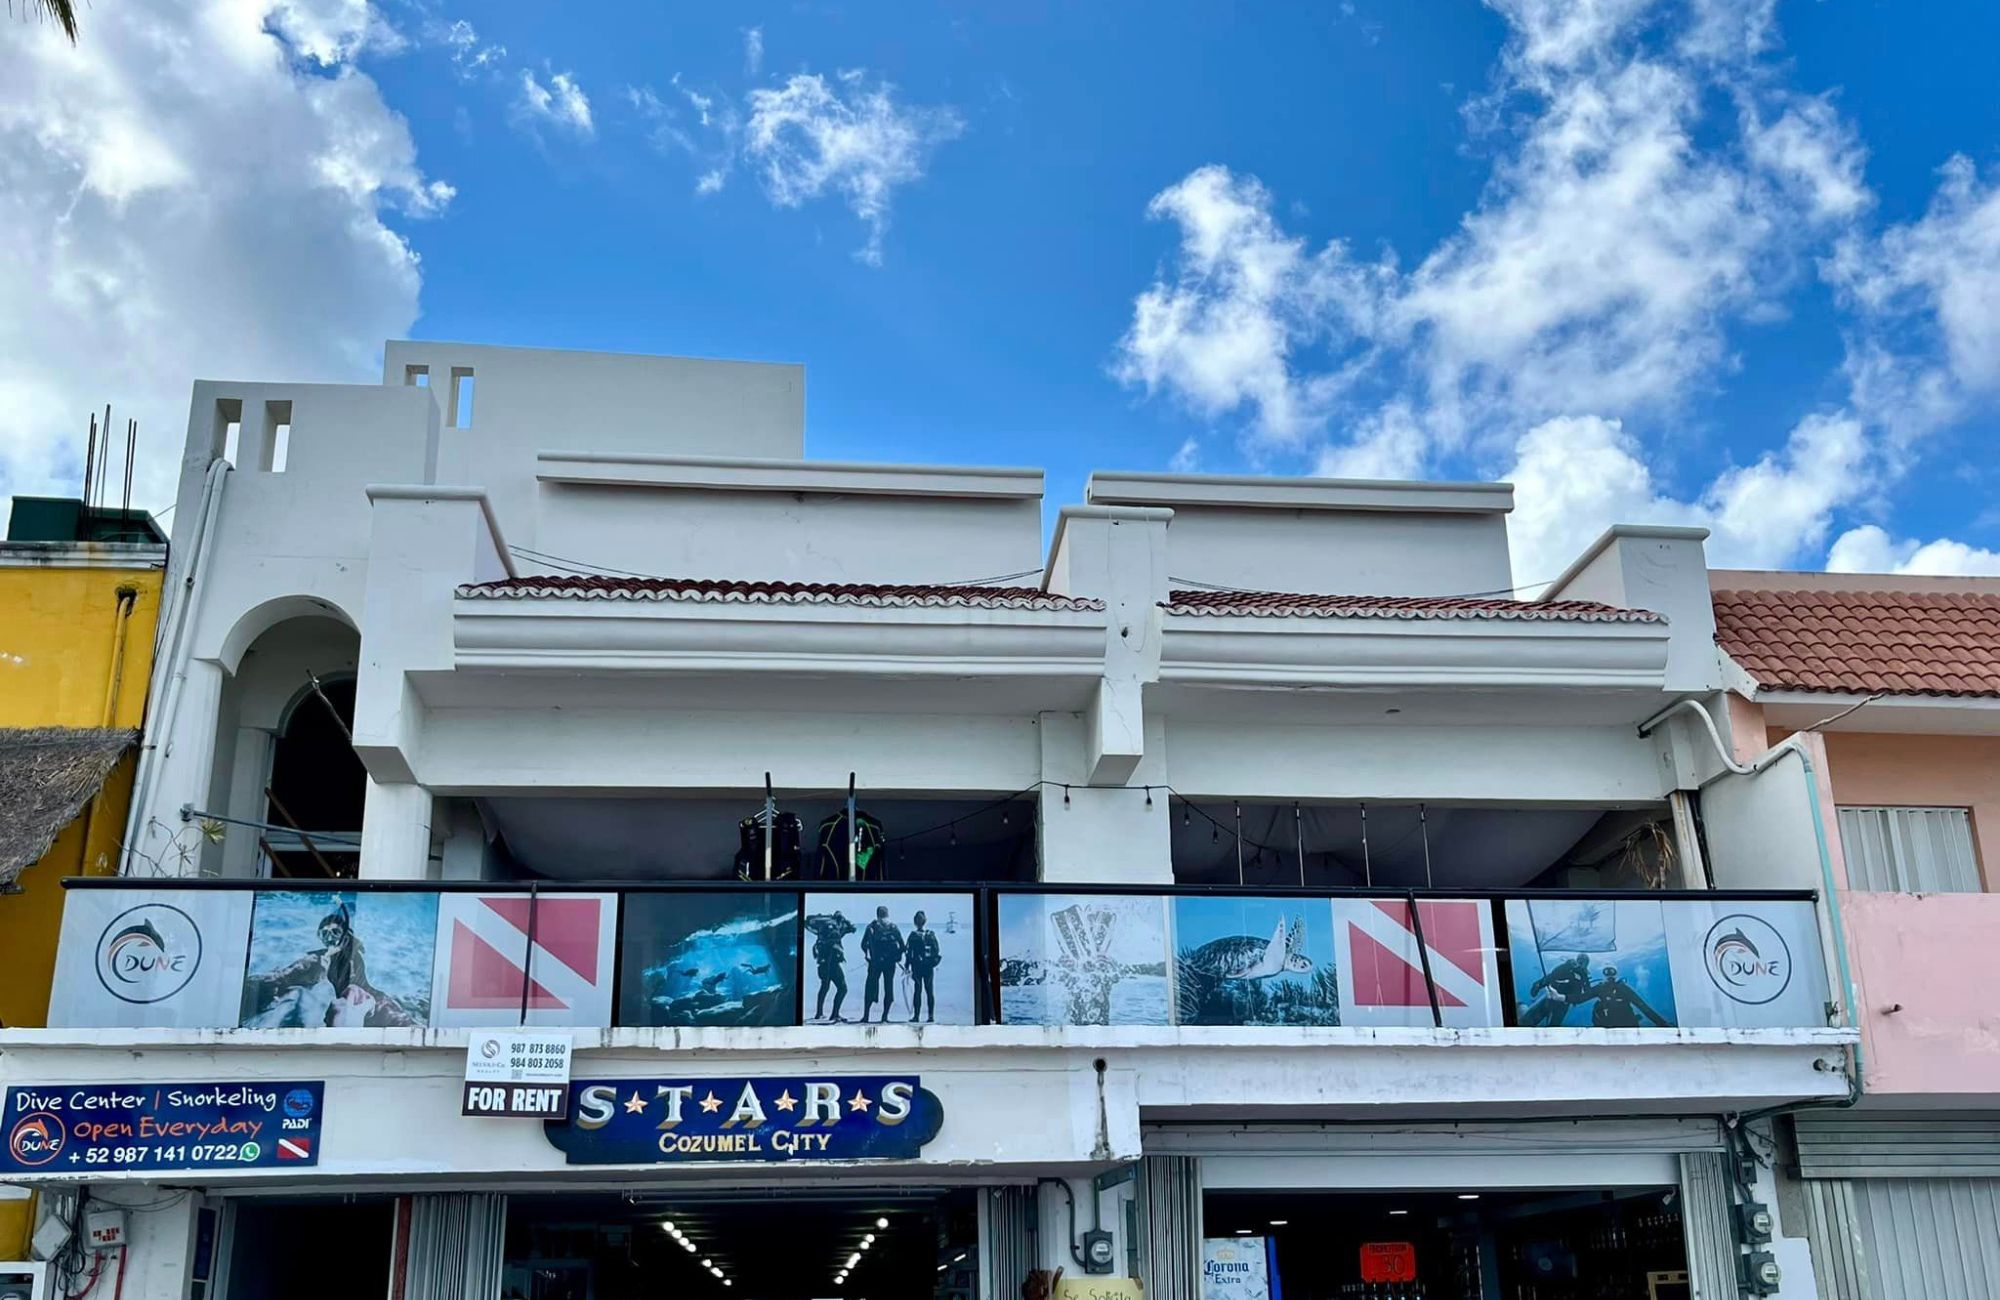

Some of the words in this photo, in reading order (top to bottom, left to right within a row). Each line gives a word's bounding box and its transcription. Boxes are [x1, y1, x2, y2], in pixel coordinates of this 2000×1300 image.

[124, 955, 186, 972] DUNE
[1729, 960, 1780, 976] DUNE
[511, 1043, 526, 1053] 987
[529, 1043, 544, 1054] 873
[510, 1057, 526, 1068] 984
[527, 1058, 543, 1068] 803
[544, 1058, 565, 1069] 2058
[16, 1092, 62, 1111] Dive
[69, 1091, 146, 1110] Center
[167, 1087, 276, 1111] Snorkeling
[468, 1087, 506, 1110] FOR
[511, 1088, 562, 1112] RENT
[74, 1121, 133, 1142] Open
[139, 1116, 262, 1141] Everyday
[282, 1118, 309, 1129] PADI
[22, 1139, 60, 1152] DUNE
[659, 1132, 762, 1153] COZUMEL
[85, 1147, 110, 1163] 52
[113, 1146, 149, 1163] 987
[154, 1145, 186, 1162] 141
[191, 1144, 238, 1161] 0722
[1203, 1259, 1249, 1276] Corona
[1215, 1273, 1241, 1284] Extra
